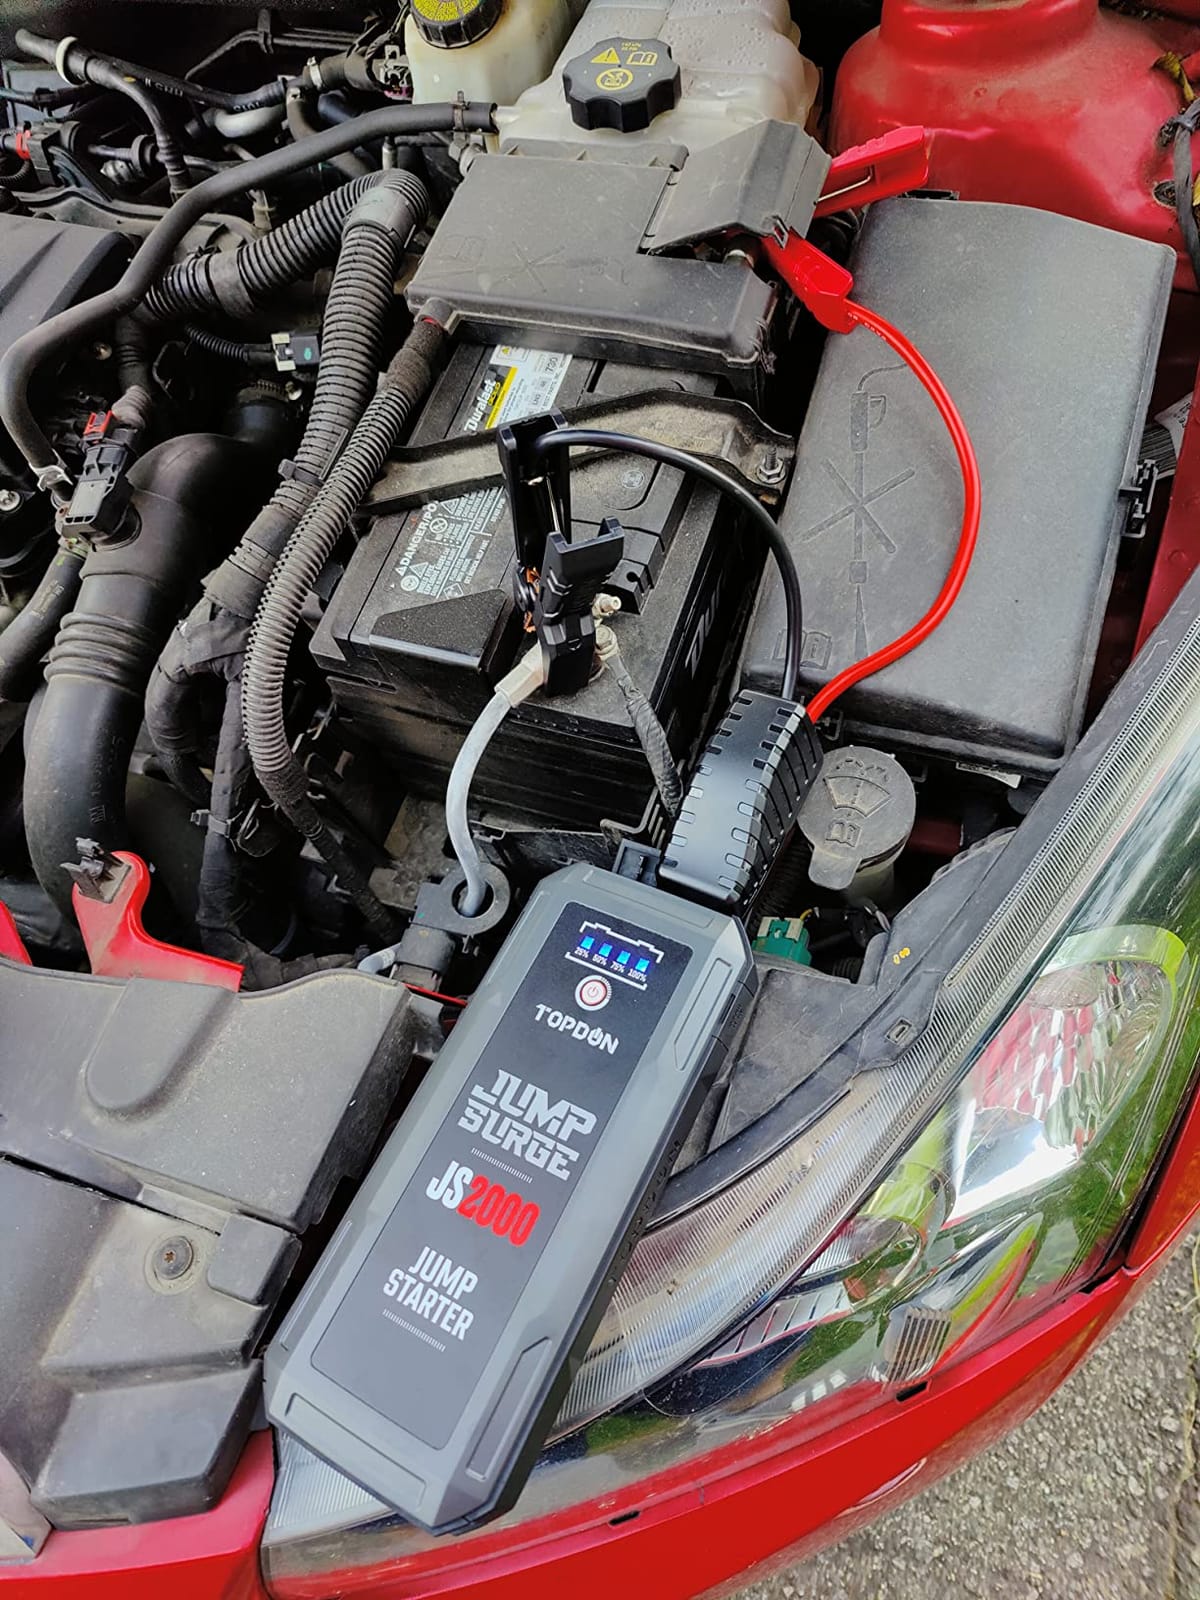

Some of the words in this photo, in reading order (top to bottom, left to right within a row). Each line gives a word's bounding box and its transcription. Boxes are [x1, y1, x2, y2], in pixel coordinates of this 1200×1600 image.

[464, 379, 497, 431] Duralast
[400, 501, 439, 567] DANGER/PO
[574, 946, 589, 958] 25%
[592, 954, 607, 966] 50%
[610, 961, 625, 973] 75%
[628, 968, 647, 982] 100%
[535, 1003, 619, 1055] TOPDON
[470, 1069, 597, 1141] JUMP
[457, 1098, 580, 1181] SURGE
[426, 1160, 541, 1247] JS2000
[383, 1268, 475, 1341] STARTER
[408, 1246, 479, 1301] JUMP
